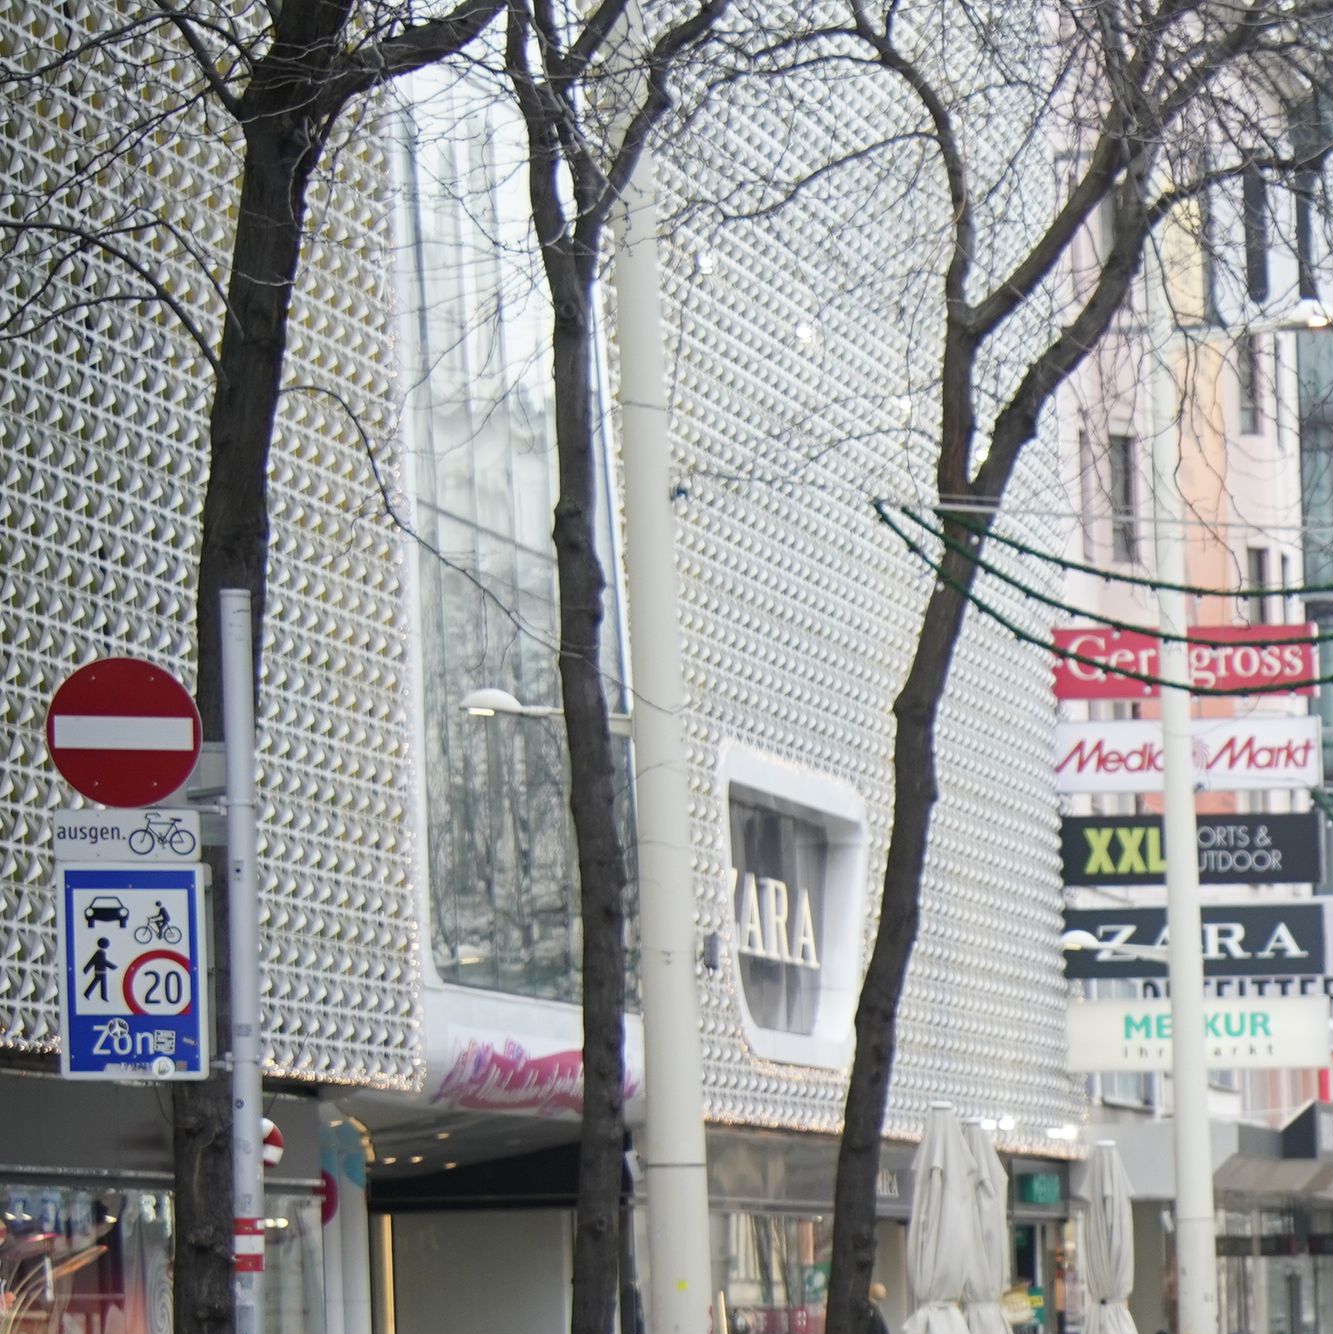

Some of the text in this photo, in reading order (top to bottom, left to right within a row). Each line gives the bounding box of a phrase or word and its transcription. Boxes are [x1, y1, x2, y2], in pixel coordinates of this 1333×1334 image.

[1066, 634, 1305, 689] Gergross
[1206, 736, 1314, 771] Markt
[57, 824, 127, 844] ausgen.
[1083, 827, 1166, 874] XXL
[731, 868, 820, 969] ARA
[143, 970, 183, 1005] 20
[93, 1024, 156, 1057] Zon
[1124, 1012, 1272, 1039] MEKUR
